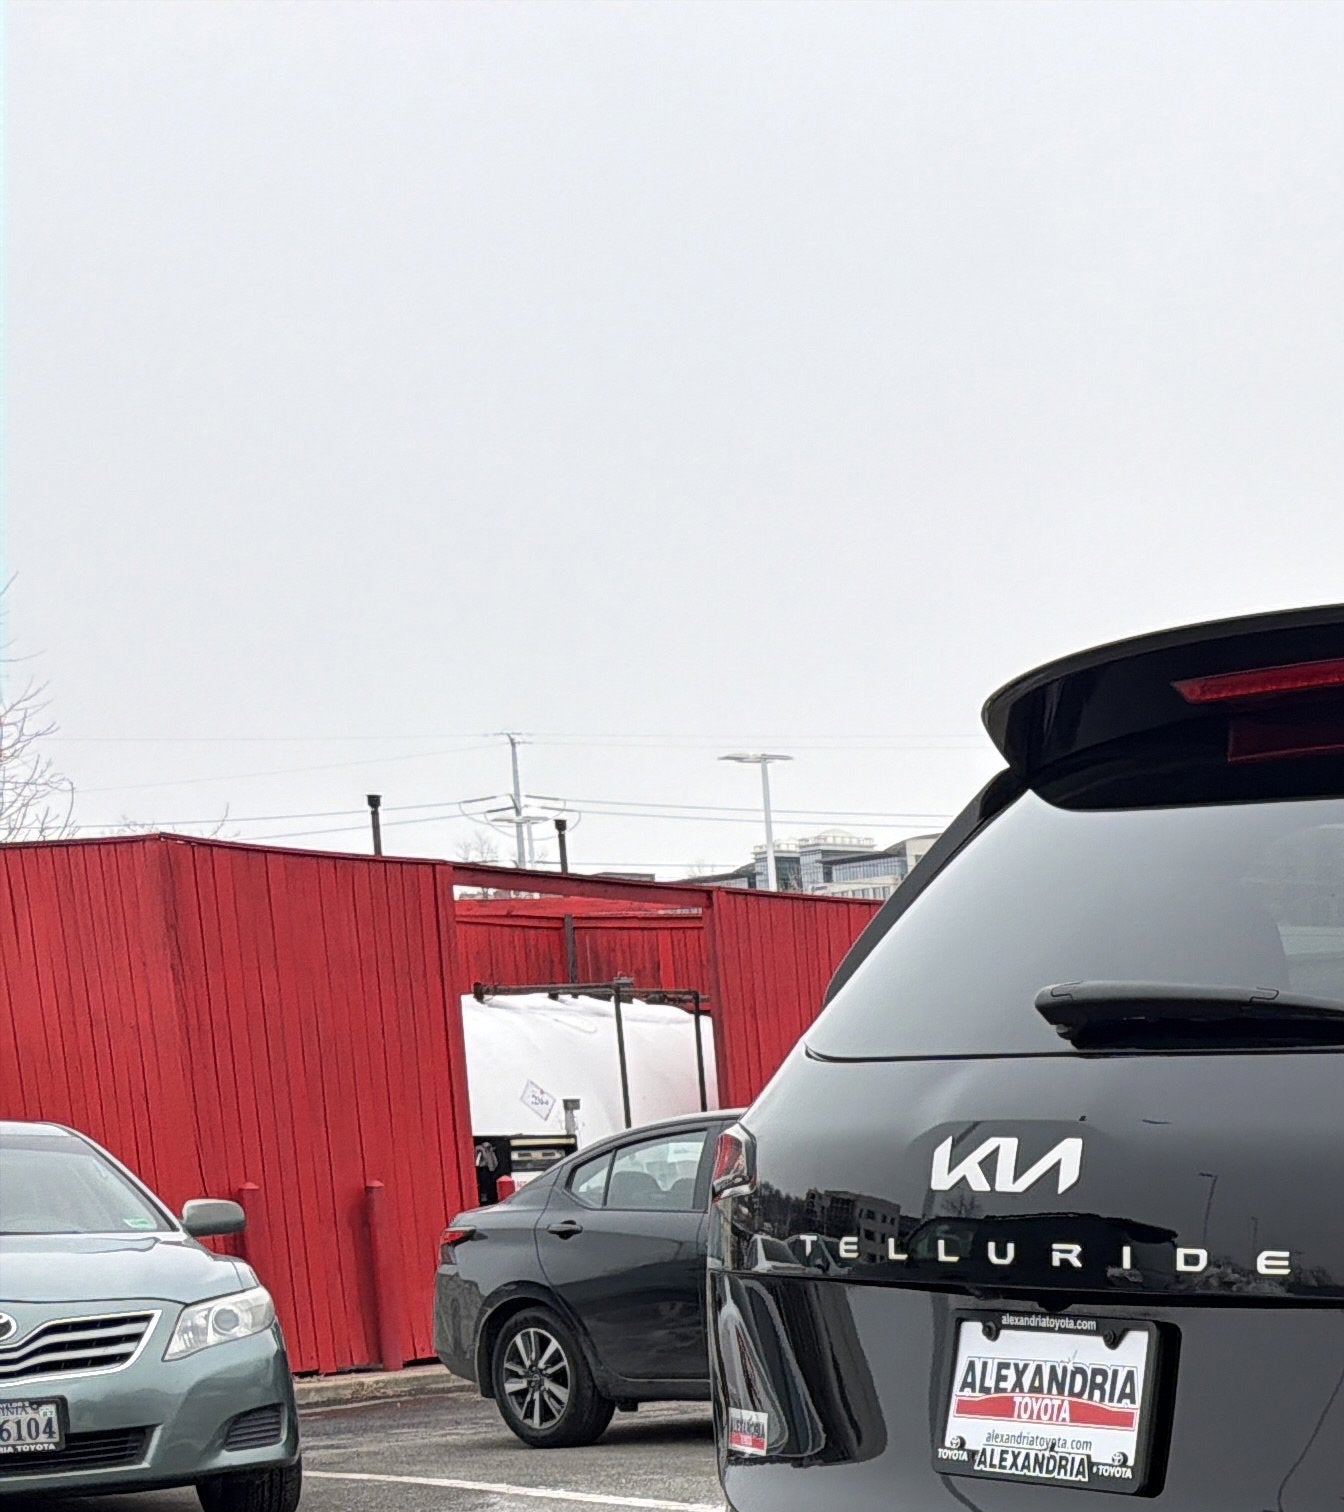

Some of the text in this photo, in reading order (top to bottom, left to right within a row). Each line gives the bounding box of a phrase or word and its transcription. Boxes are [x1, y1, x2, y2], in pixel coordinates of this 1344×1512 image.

[931, 1135, 1083, 1194] KIA
[800, 1234, 1292, 1276] TELLURIDE
[1001, 1313, 1097, 1331] alexandriatoyota.com
[958, 1358, 1138, 1406] ALEXANDRIA
[1012, 1396, 1071, 1423] TOYOTA
[0, 1417, 57, 1442] 6104
[985, 1429, 1093, 1452] alexandriatoyota.com
[16, 1443, 56, 1452] TOYOTA
[937, 1448, 969, 1462] TOYOTA
[974, 1448, 1089, 1482] ALEXANDRIA
[1098, 1464, 1133, 1479] TOYOTA
